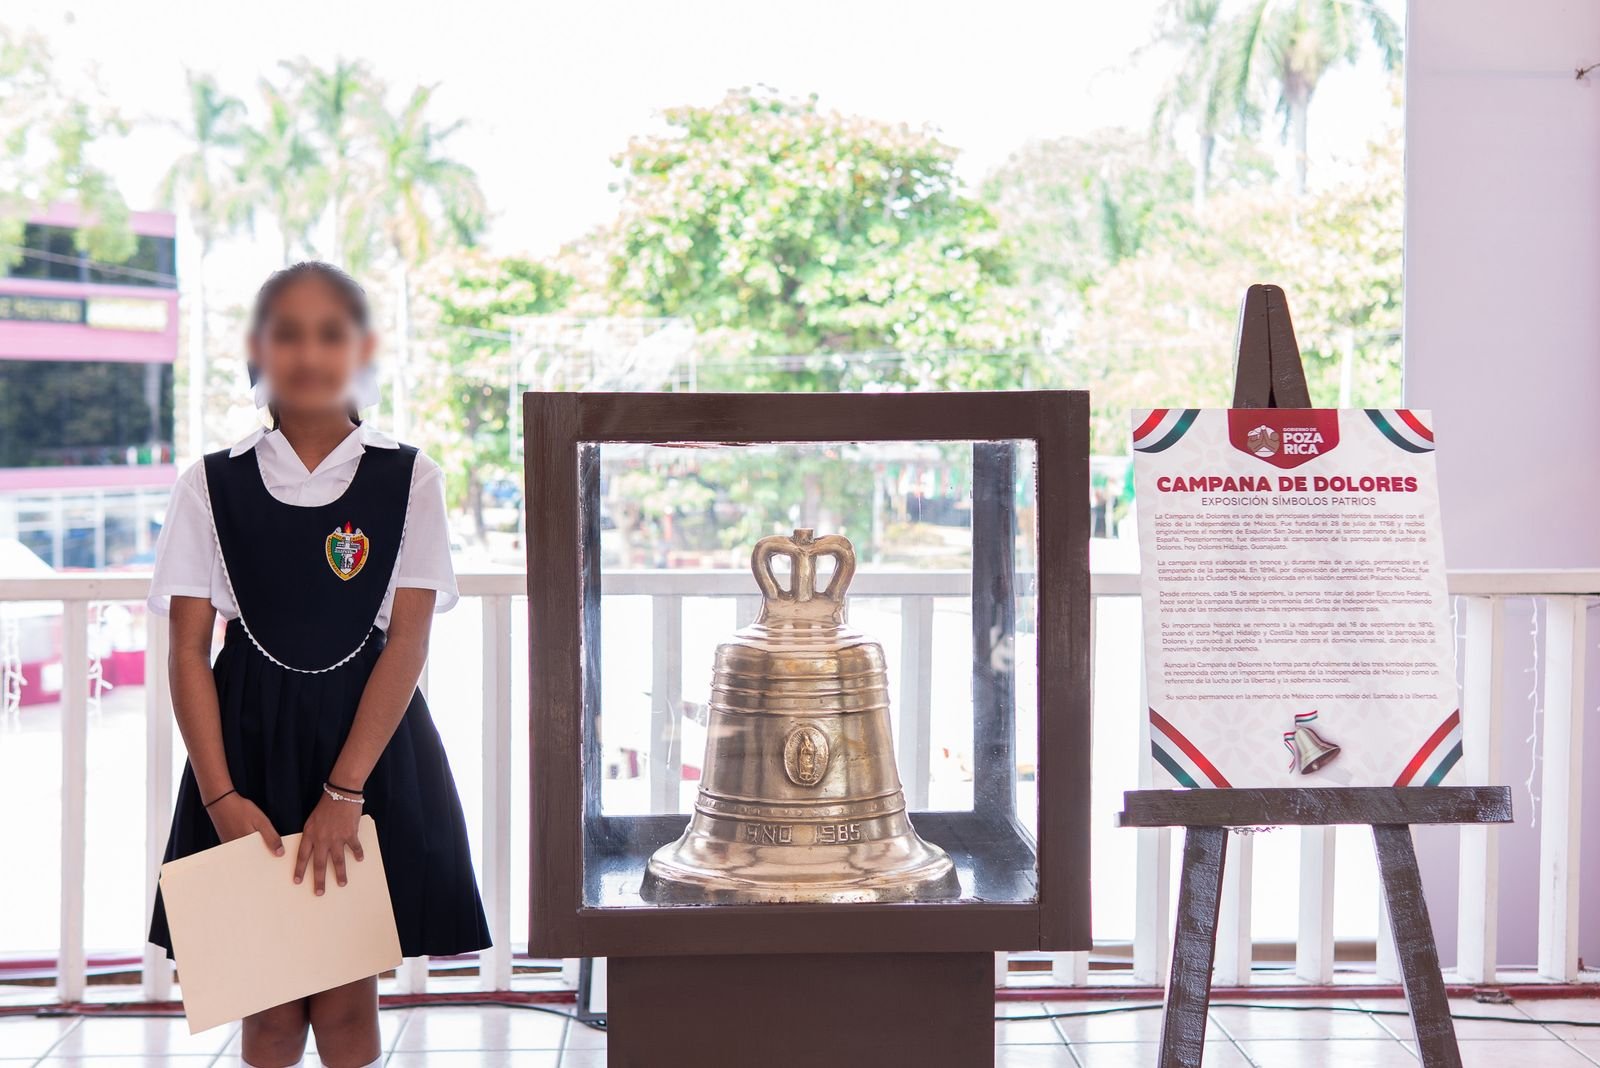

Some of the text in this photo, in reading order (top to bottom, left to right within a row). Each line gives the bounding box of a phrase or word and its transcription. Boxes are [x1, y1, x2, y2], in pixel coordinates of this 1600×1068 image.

[1282, 432, 1324, 444] POZA
[1283, 443, 1319, 455] RICA
[1157, 476, 1418, 492] CAMPANA DE DOLORES
[1201, 495, 1377, 506] EXPOSICIÓN SÍMBOLOS PATRIOS
